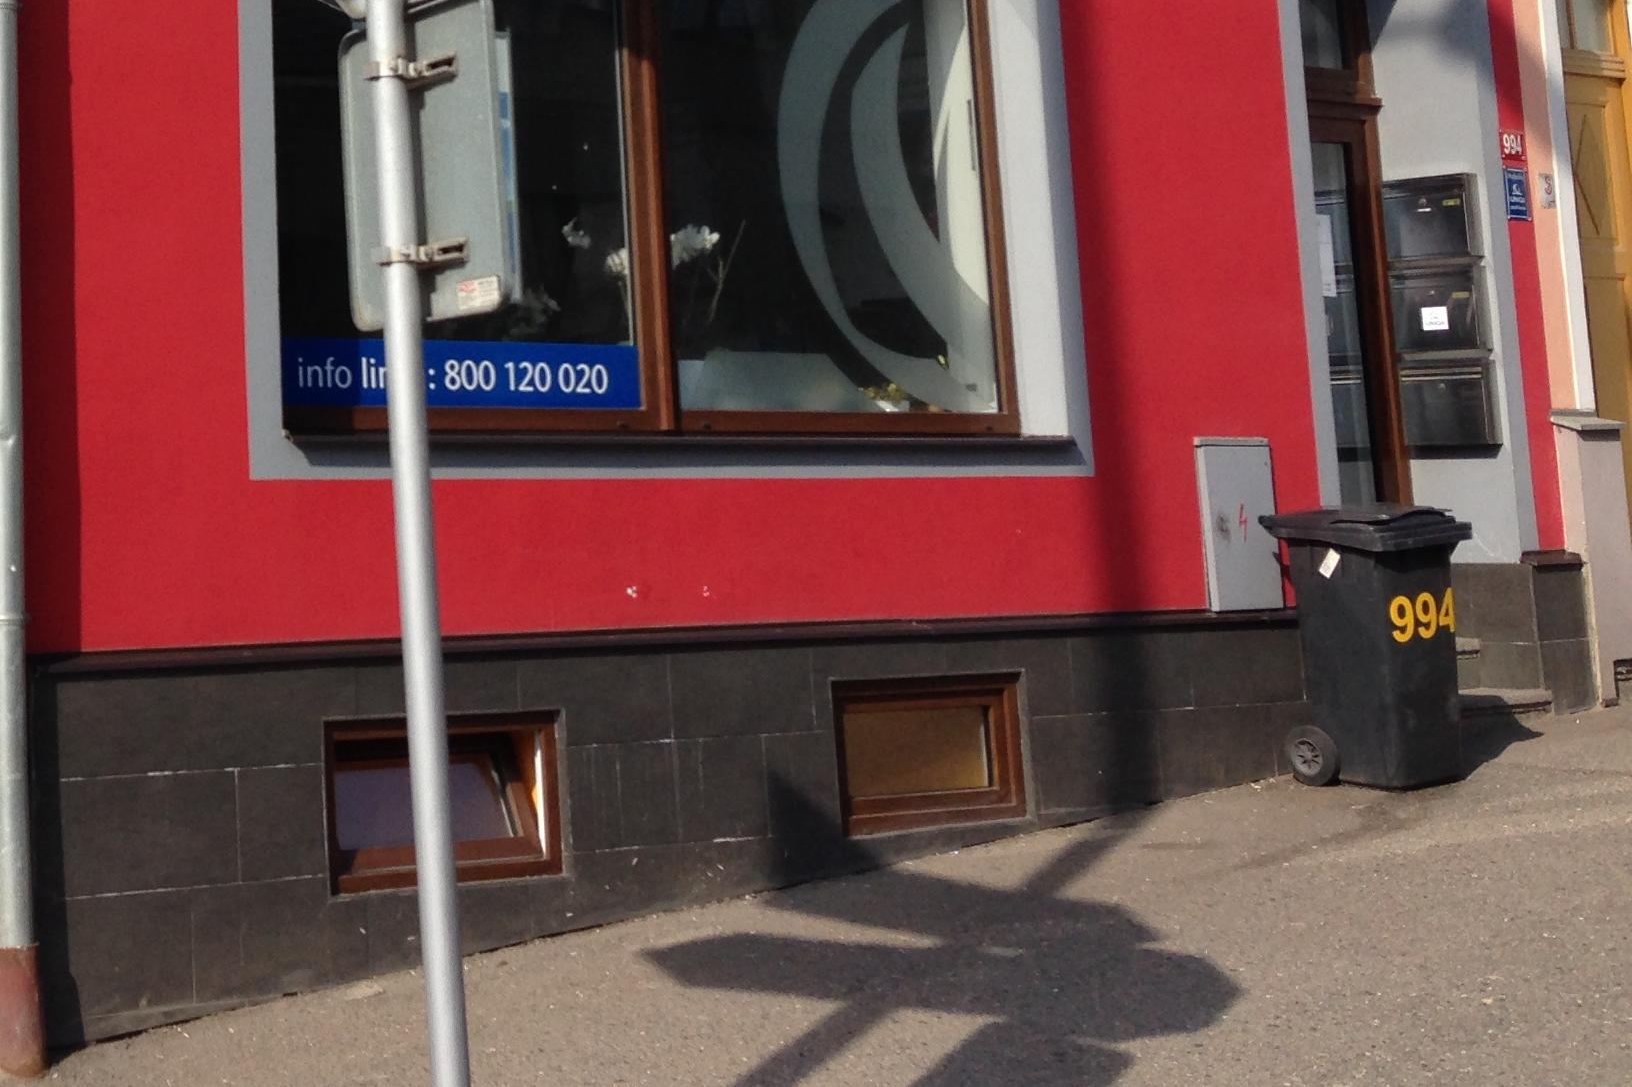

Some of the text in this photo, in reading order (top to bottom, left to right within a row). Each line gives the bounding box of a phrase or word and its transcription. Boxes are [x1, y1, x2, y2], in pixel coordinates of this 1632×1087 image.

[1502, 133, 1523, 156] 994
[298, 356, 352, 389] info
[444, 359, 496, 392] 800
[504, 361, 552, 393] 120
[558, 363, 608, 395] 020
[1389, 587, 1456, 643] 994
